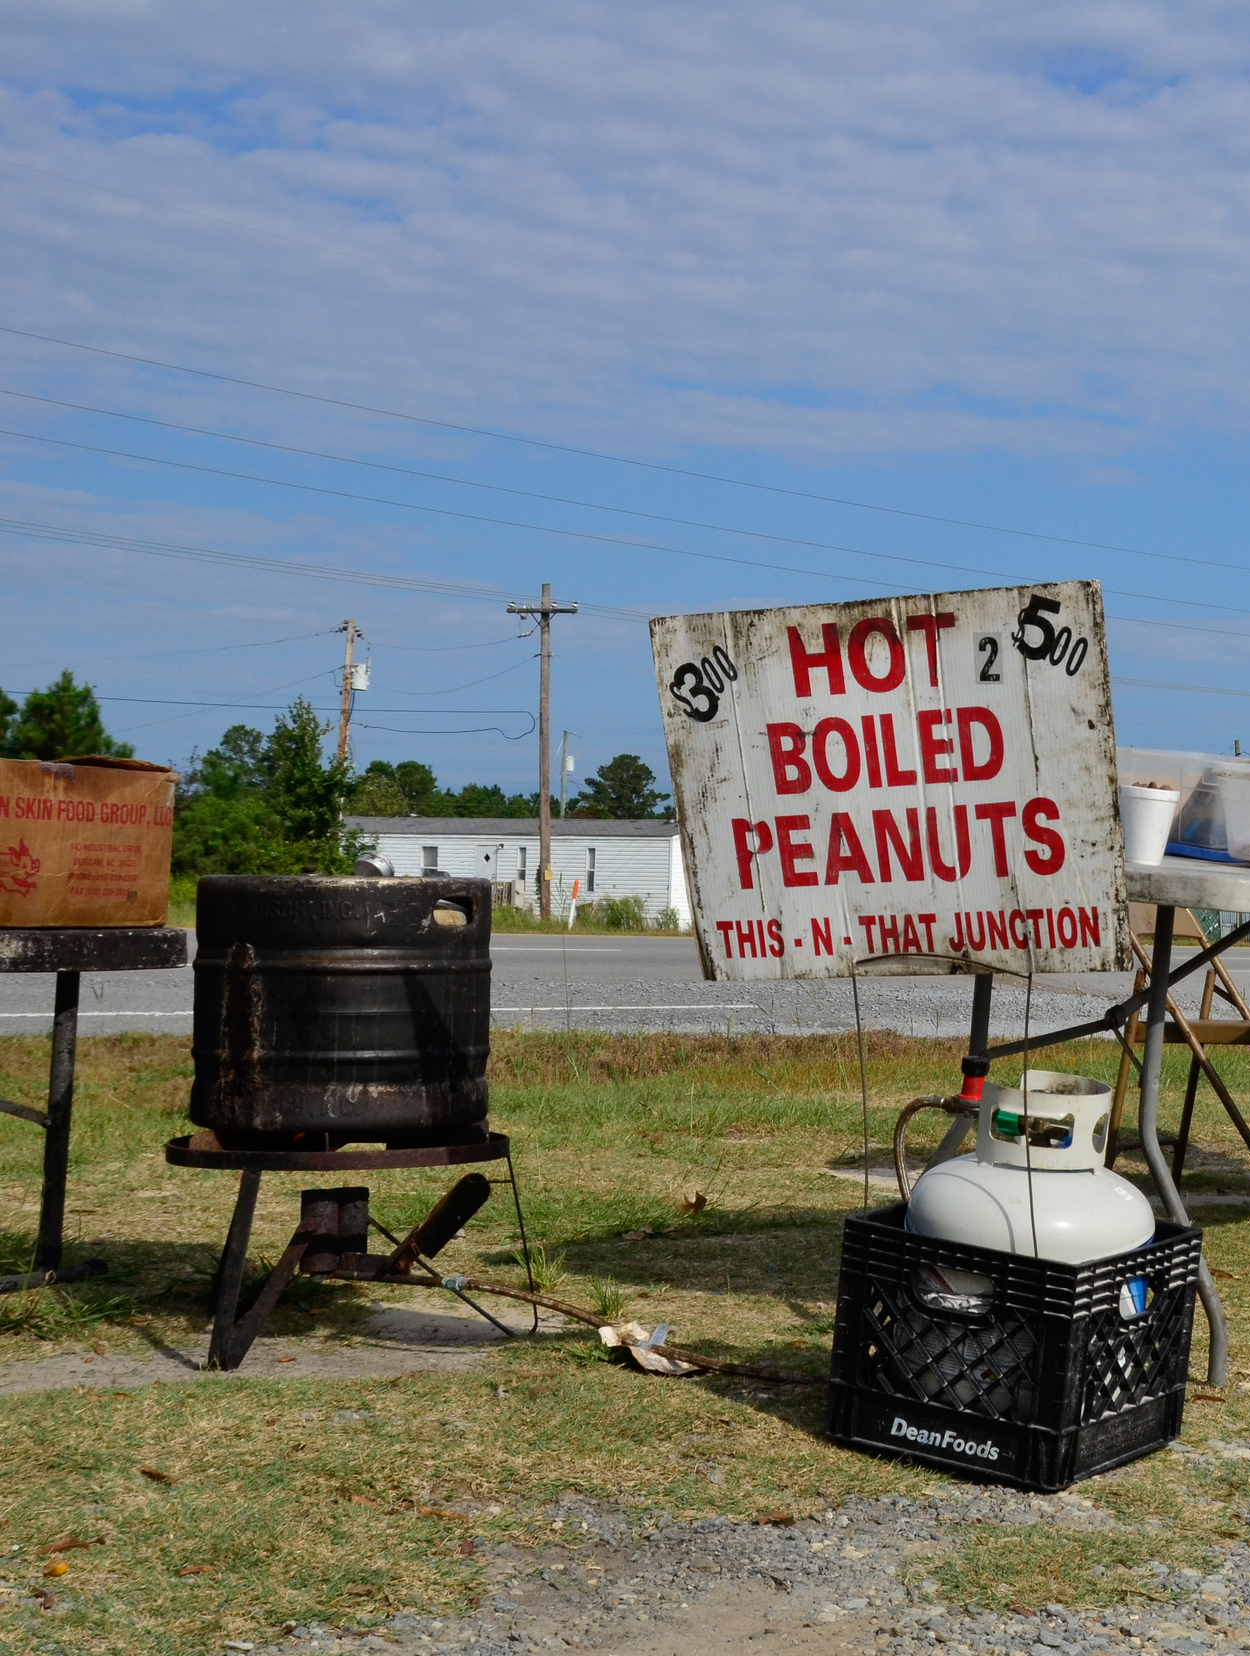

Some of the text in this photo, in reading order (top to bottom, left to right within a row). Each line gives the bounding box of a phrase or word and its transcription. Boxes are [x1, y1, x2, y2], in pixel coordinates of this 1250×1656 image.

[786, 611, 956, 698] HOT
[978, 636, 1001, 682] 2
[766, 705, 1004, 795] BOILED
[15, 797, 53, 820] SKIN
[57, 800, 95, 822] FOOD
[100, 803, 150, 829] GROUP,
[153, 806, 173, 827] LLC
[83, 843, 121, 853] INDUSTRIAL
[731, 797, 1065, 890] PEANUTS
[716, 918, 785, 959] THIS
[858, 913, 937, 955] THAT
[948, 906, 1100, 953] JUNCTION
[890, 1417, 1000, 1461] DeanFoods
